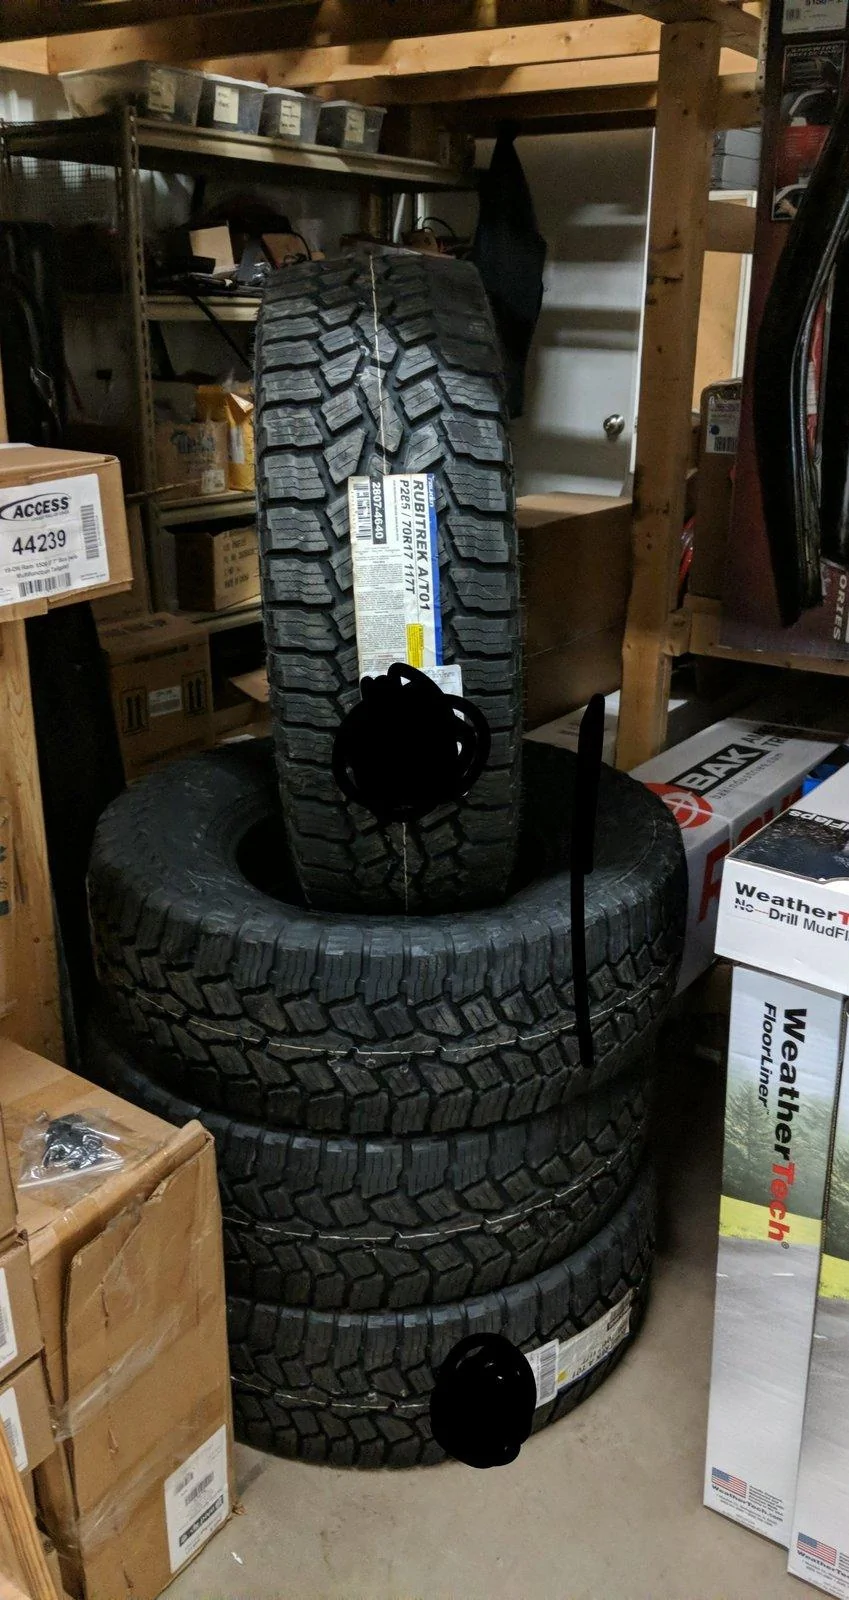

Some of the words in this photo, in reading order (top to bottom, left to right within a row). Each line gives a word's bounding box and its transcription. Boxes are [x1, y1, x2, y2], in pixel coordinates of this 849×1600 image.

[13, 497, 70, 519] ACCESS
[371, 481, 384, 540] 2807-4640
[399, 479, 411, 510] P285
[402, 521, 413, 560] 70R17
[413, 479, 427, 562] RUBITREK
[13, 530, 67, 556] 44239
[404, 562, 415, 595] 117T
[417, 566, 430, 611] A/T01
[833, 575, 846, 640] ORIES
[675, 748, 766, 791] BAK
